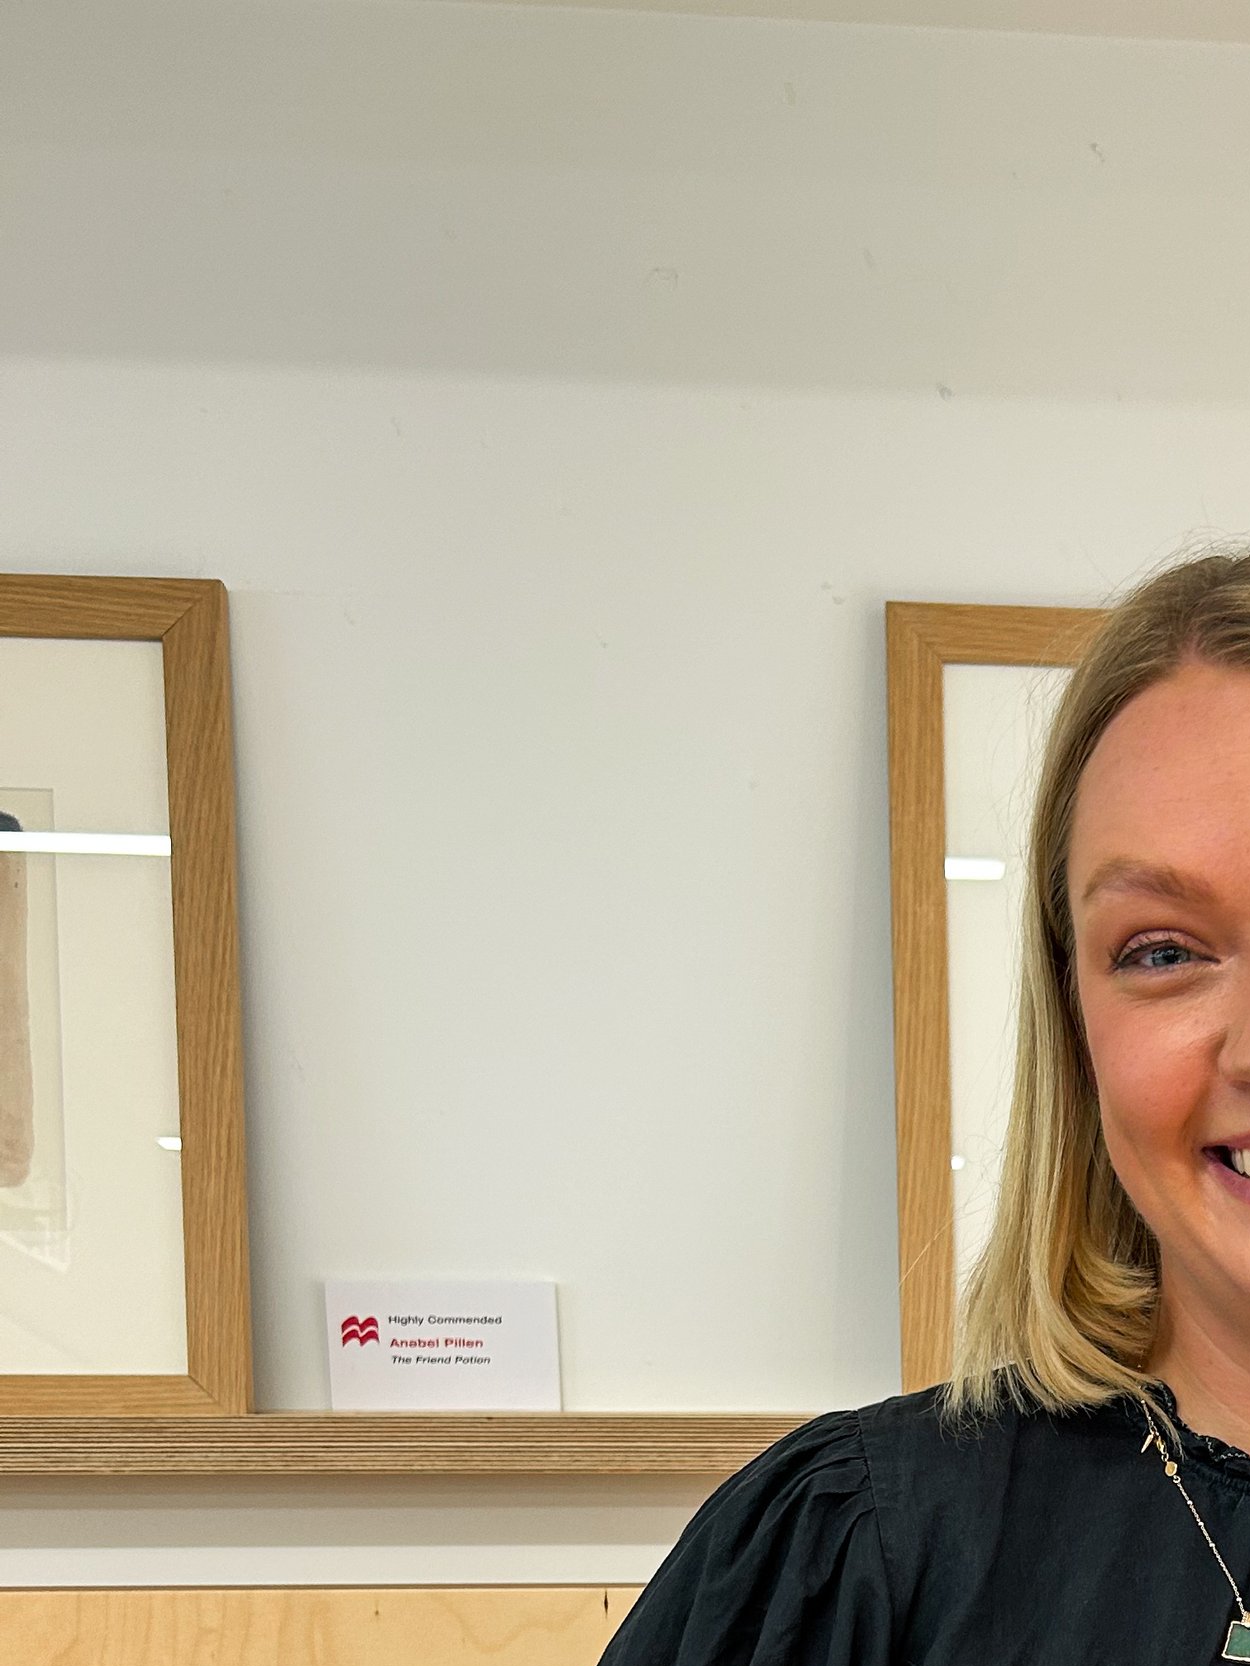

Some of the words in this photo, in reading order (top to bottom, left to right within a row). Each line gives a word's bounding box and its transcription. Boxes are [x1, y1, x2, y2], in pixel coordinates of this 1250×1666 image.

[388, 1315, 424, 1326] Highly
[428, 1315, 502, 1326] Commended
[390, 1338, 439, 1348] Anabel
[445, 1338, 483, 1348] Pillen
[391, 1356, 412, 1365] The
[416, 1356, 451, 1365] Friend
[455, 1356, 491, 1365] Potion
